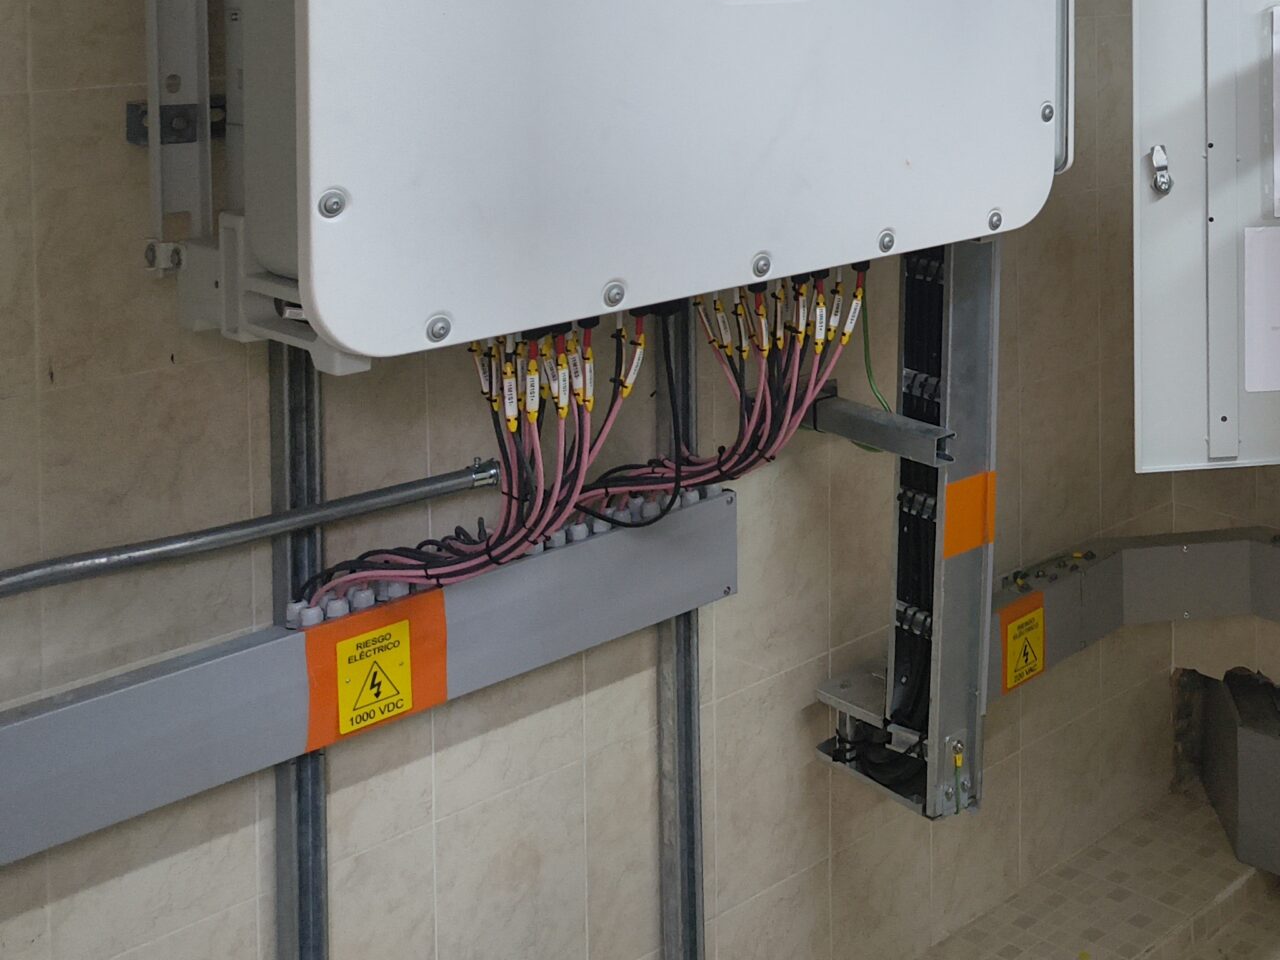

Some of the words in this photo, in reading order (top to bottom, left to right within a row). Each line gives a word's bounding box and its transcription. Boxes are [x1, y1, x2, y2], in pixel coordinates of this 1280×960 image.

[347, 640, 400, 664] ELÉCTRICO
[356, 633, 392, 650] RIESGO
[350, 708, 376, 726] 1000
[379, 698, 405, 716] VDC
